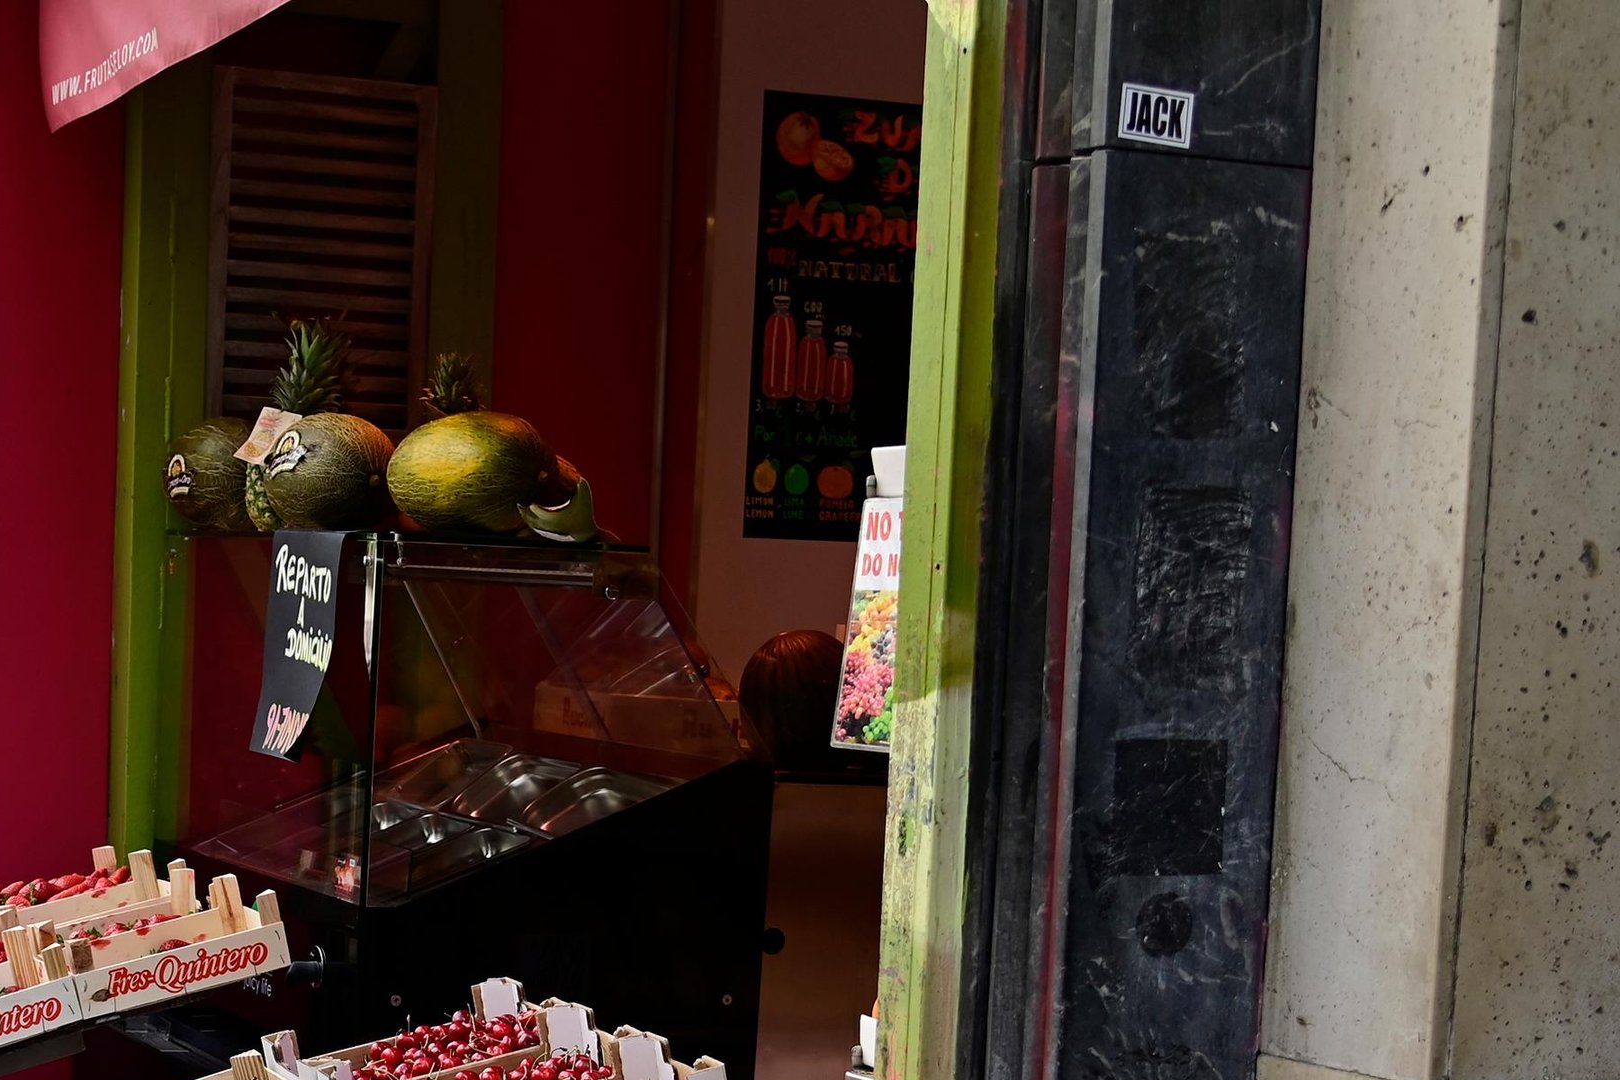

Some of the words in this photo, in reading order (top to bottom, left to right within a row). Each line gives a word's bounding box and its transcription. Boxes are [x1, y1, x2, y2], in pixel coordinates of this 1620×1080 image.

[1126, 91, 1185, 140] JACK
[798, 259, 902, 284] NATURAL
[866, 511, 892, 541] NO
[275, 543, 332, 604] REPARTO
[861, 553, 882, 577] DO
[106, 941, 269, 998] Fres-Quintero
